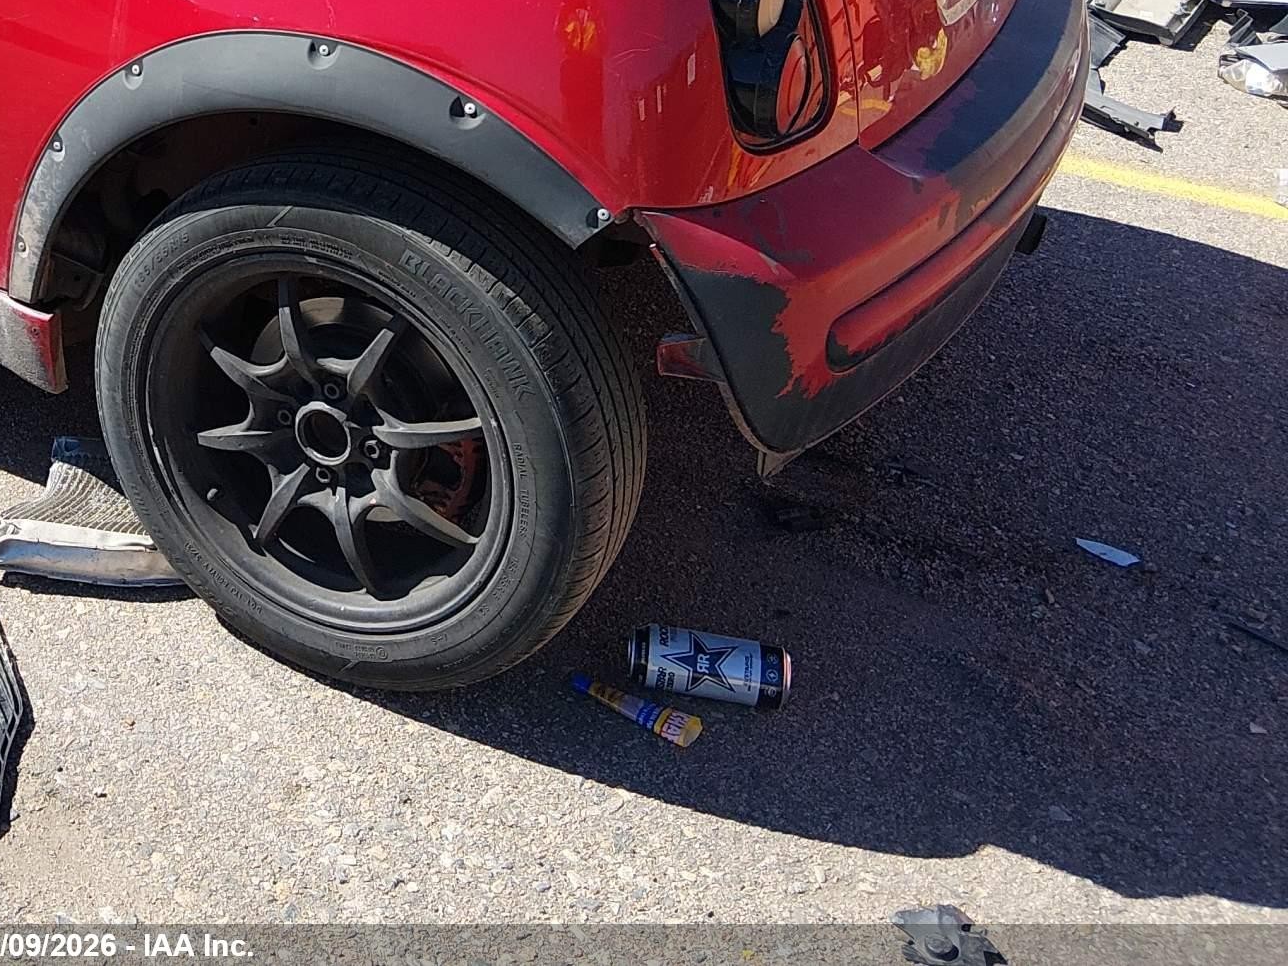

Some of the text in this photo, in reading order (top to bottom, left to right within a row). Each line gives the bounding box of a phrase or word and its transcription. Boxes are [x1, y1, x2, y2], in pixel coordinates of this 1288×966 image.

[398, 248, 537, 402] BLACKHAWK
[513, 441, 531, 539] RADIAL TUBELESS
